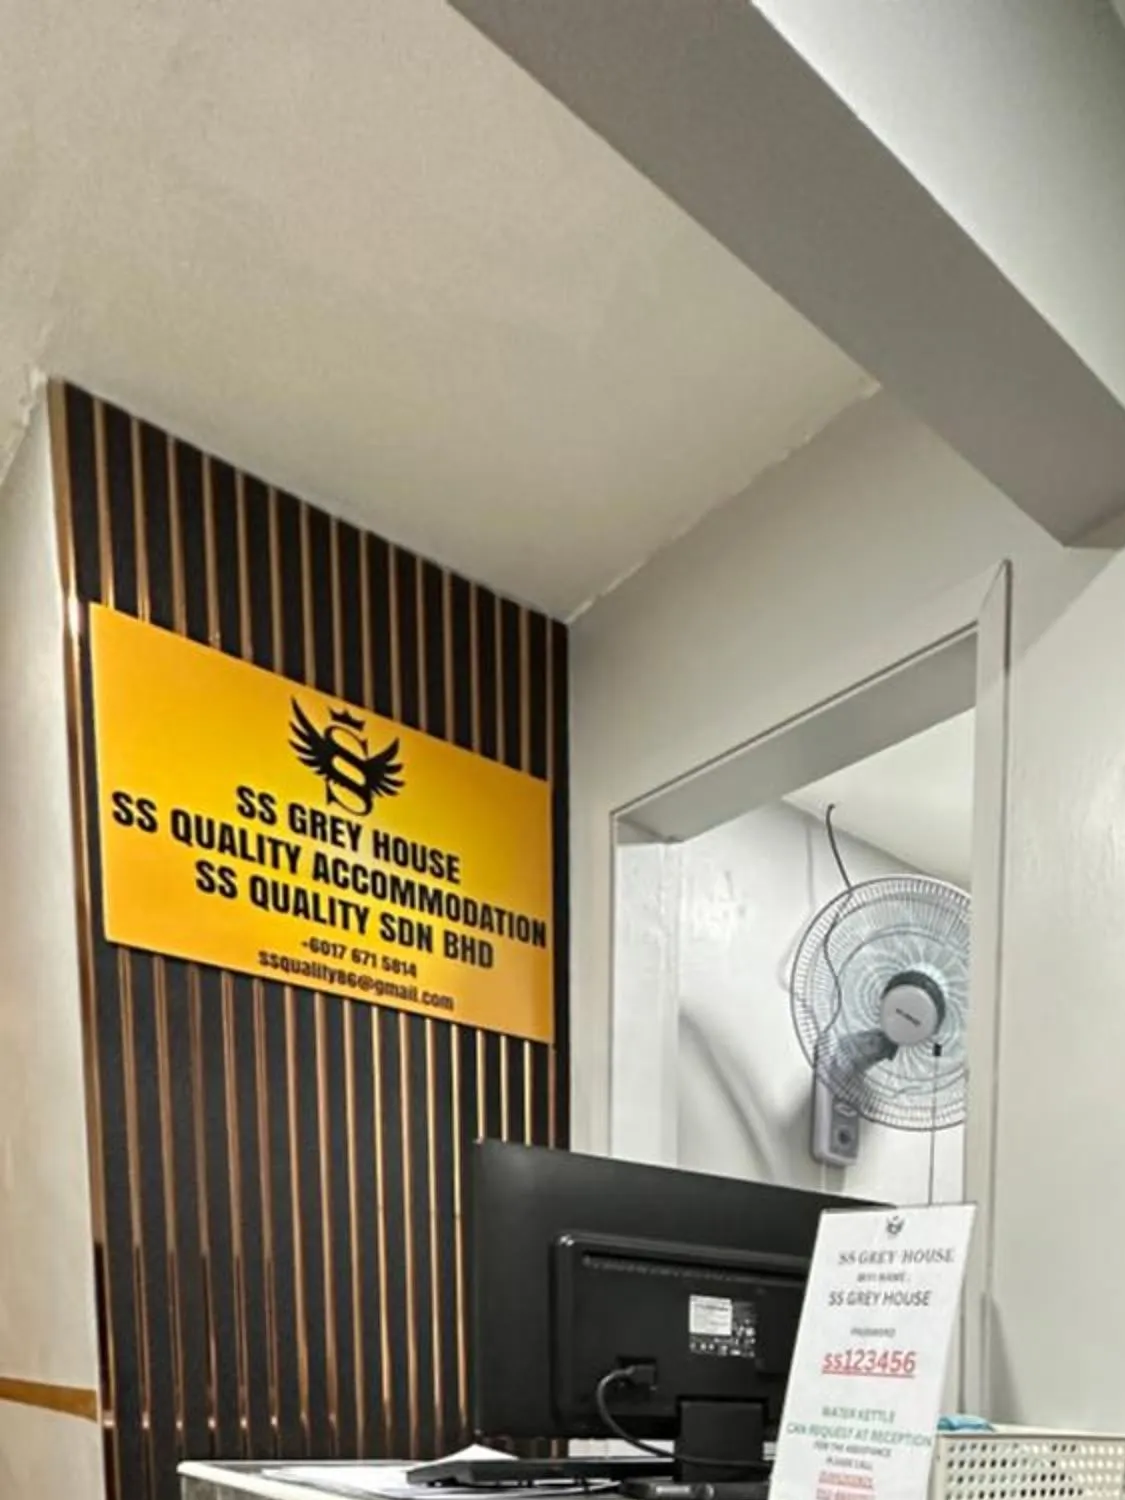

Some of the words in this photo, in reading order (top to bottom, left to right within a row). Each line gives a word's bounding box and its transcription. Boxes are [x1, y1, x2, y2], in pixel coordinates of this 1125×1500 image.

[236, 785, 277, 825] SS
[288, 802, 362, 852] GREY
[372, 830, 461, 884] HOUSE
[111, 791, 158, 833] SS
[170, 808, 302, 874] QUALITY
[312, 852, 548, 948] ACCOMMODATION
[195, 860, 238, 899] SS
[249, 875, 369, 936] QUALITY
[380, 915, 434, 953] SDN
[443, 936, 494, 969] BHD
[351, 948, 377, 967] 671
[838, 1250, 856, 1265] SS
[858, 1249, 897, 1265] GREY
[901, 1247, 956, 1264] HOUSE
[828, 1290, 844, 1306] SS
[845, 1290, 881, 1307] GREY
[882, 1290, 932, 1307] HOUSE
[858, 1408, 895, 1423] KETTLE
[786, 1422, 806, 1435] CAN
[809, 1424, 854, 1439] REQUEST
[855, 1428, 869, 1441] AT
[870, 1429, 932, 1447] RECEPTION
